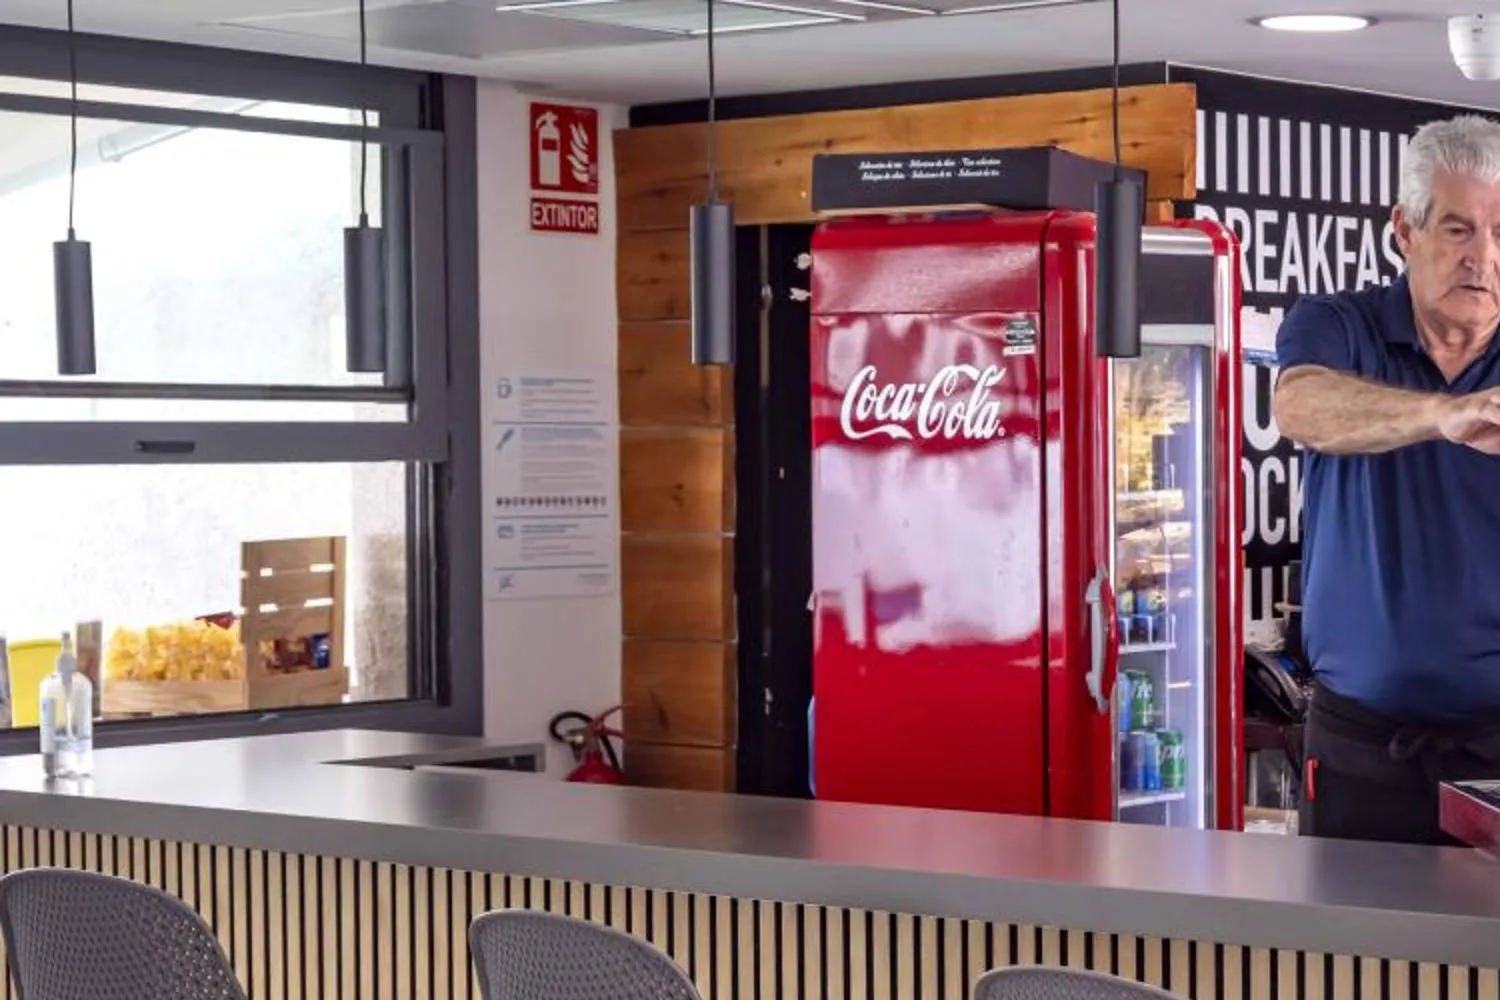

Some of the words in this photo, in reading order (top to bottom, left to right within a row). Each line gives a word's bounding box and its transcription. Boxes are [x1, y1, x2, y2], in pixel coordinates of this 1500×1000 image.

[532, 203, 597, 230] EXTINTOR
[1194, 204, 1404, 295] REAKFAS
[840, 363, 1003, 440] Coca-Cola
